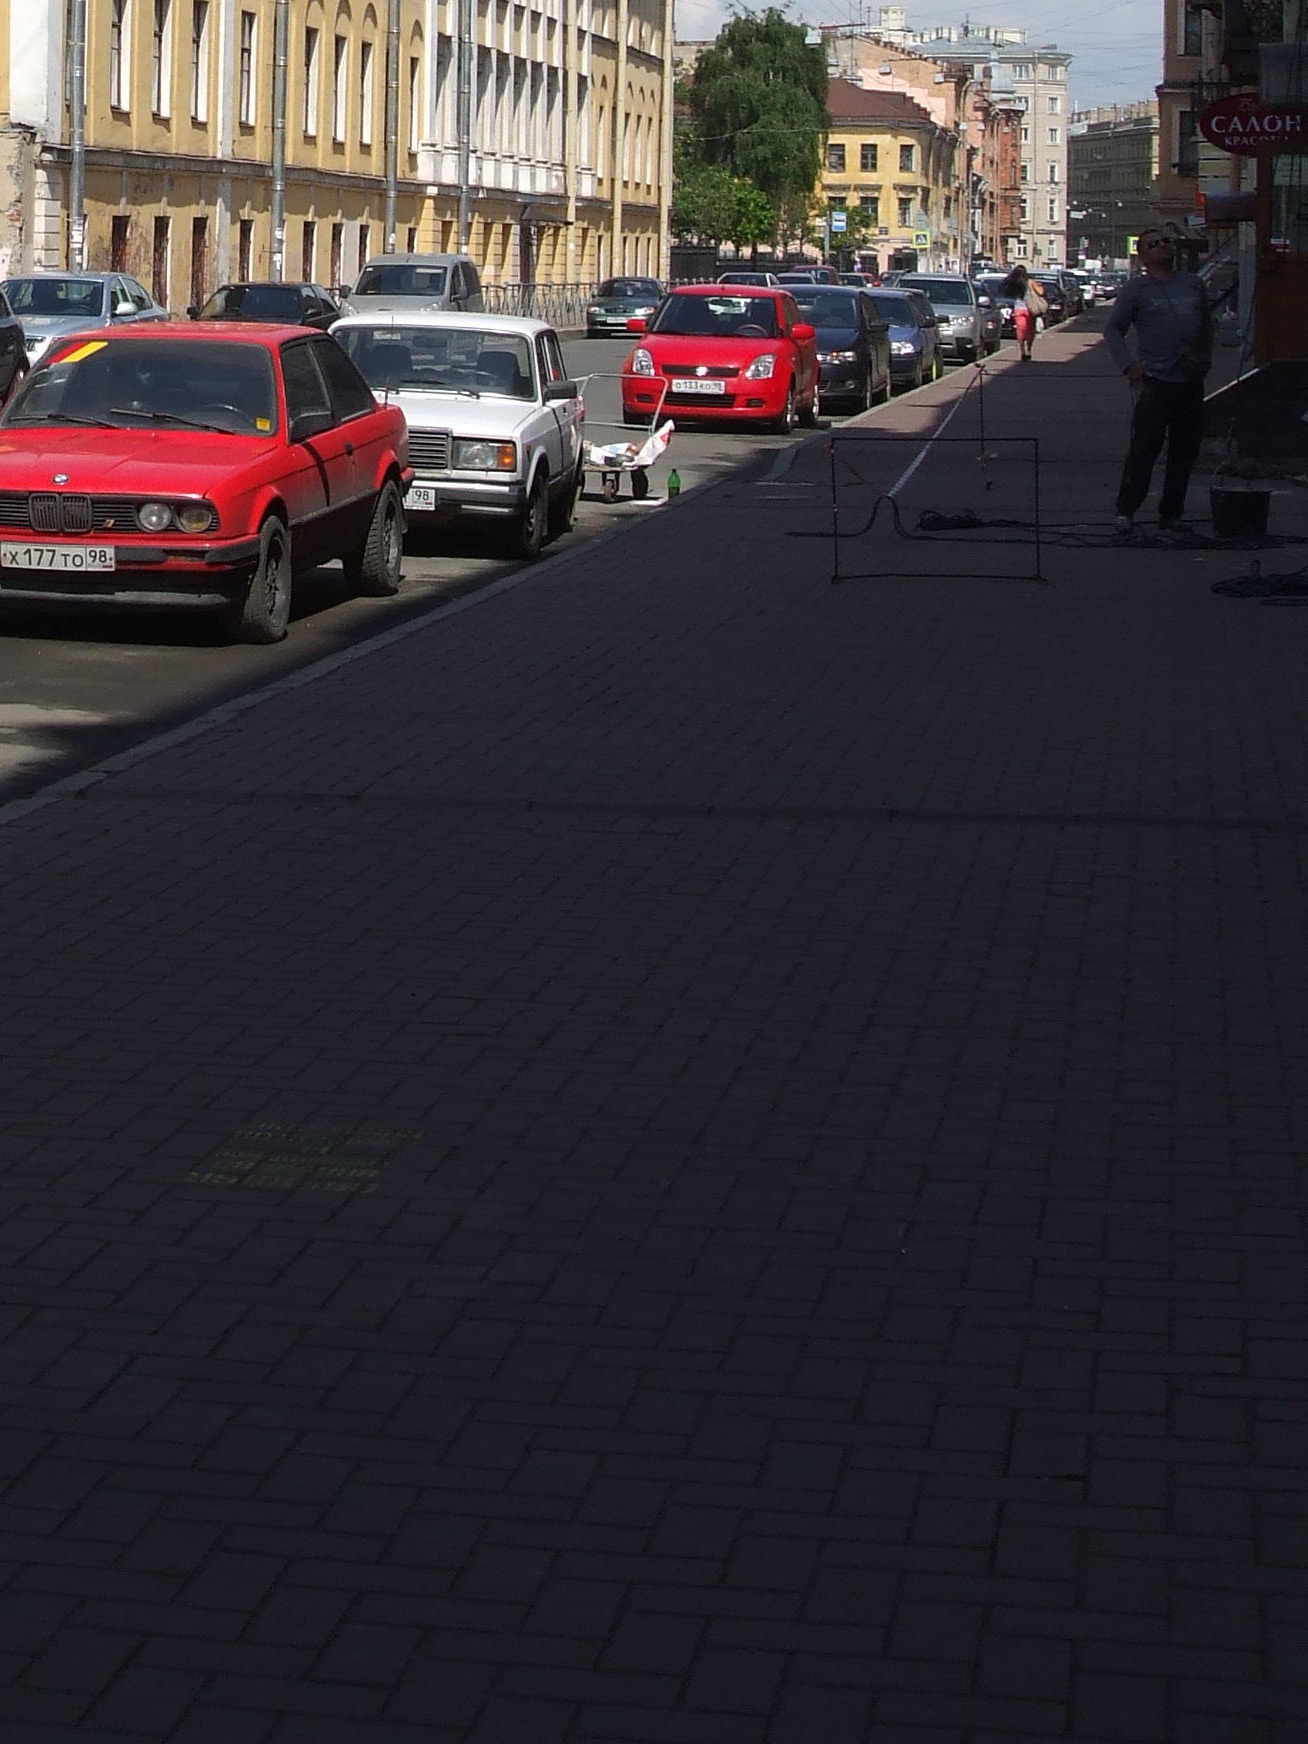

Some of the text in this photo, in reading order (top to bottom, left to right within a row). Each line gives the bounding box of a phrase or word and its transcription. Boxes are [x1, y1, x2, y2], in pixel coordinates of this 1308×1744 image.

[1210, 115, 1301, 133] САЛОН
[1224, 136, 1288, 146] КРАС
[415, 490, 429, 500] 98
